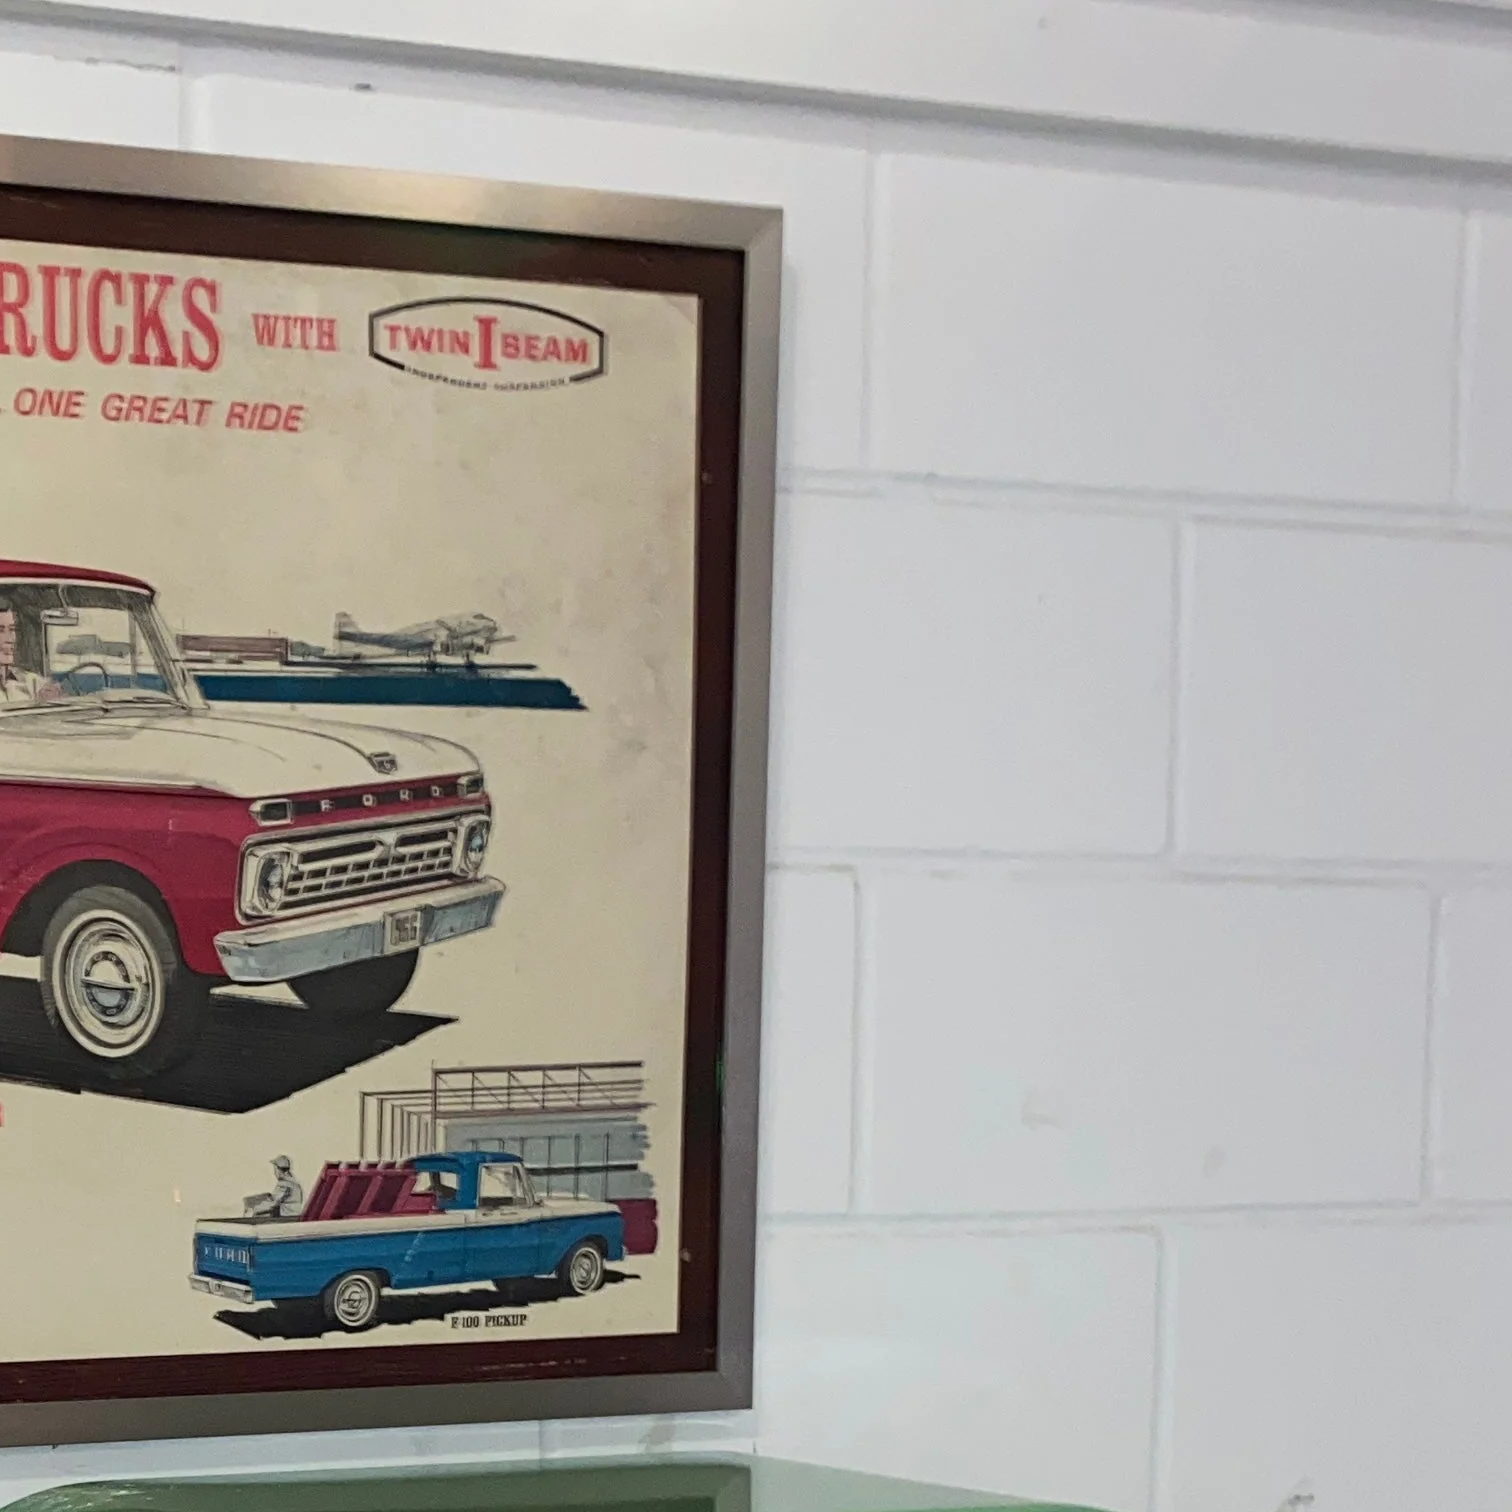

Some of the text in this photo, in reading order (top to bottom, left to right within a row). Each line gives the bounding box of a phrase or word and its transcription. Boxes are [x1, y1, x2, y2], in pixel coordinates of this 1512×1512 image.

[251, 312, 339, 352] WITH
[383, 314, 591, 371] TWIN I BEAM
[13, 387, 87, 418] ONE
[101, 392, 215, 426] GREAT
[225, 401, 305, 433] RIDE
[484, 1313, 528, 1327] PICKUP
